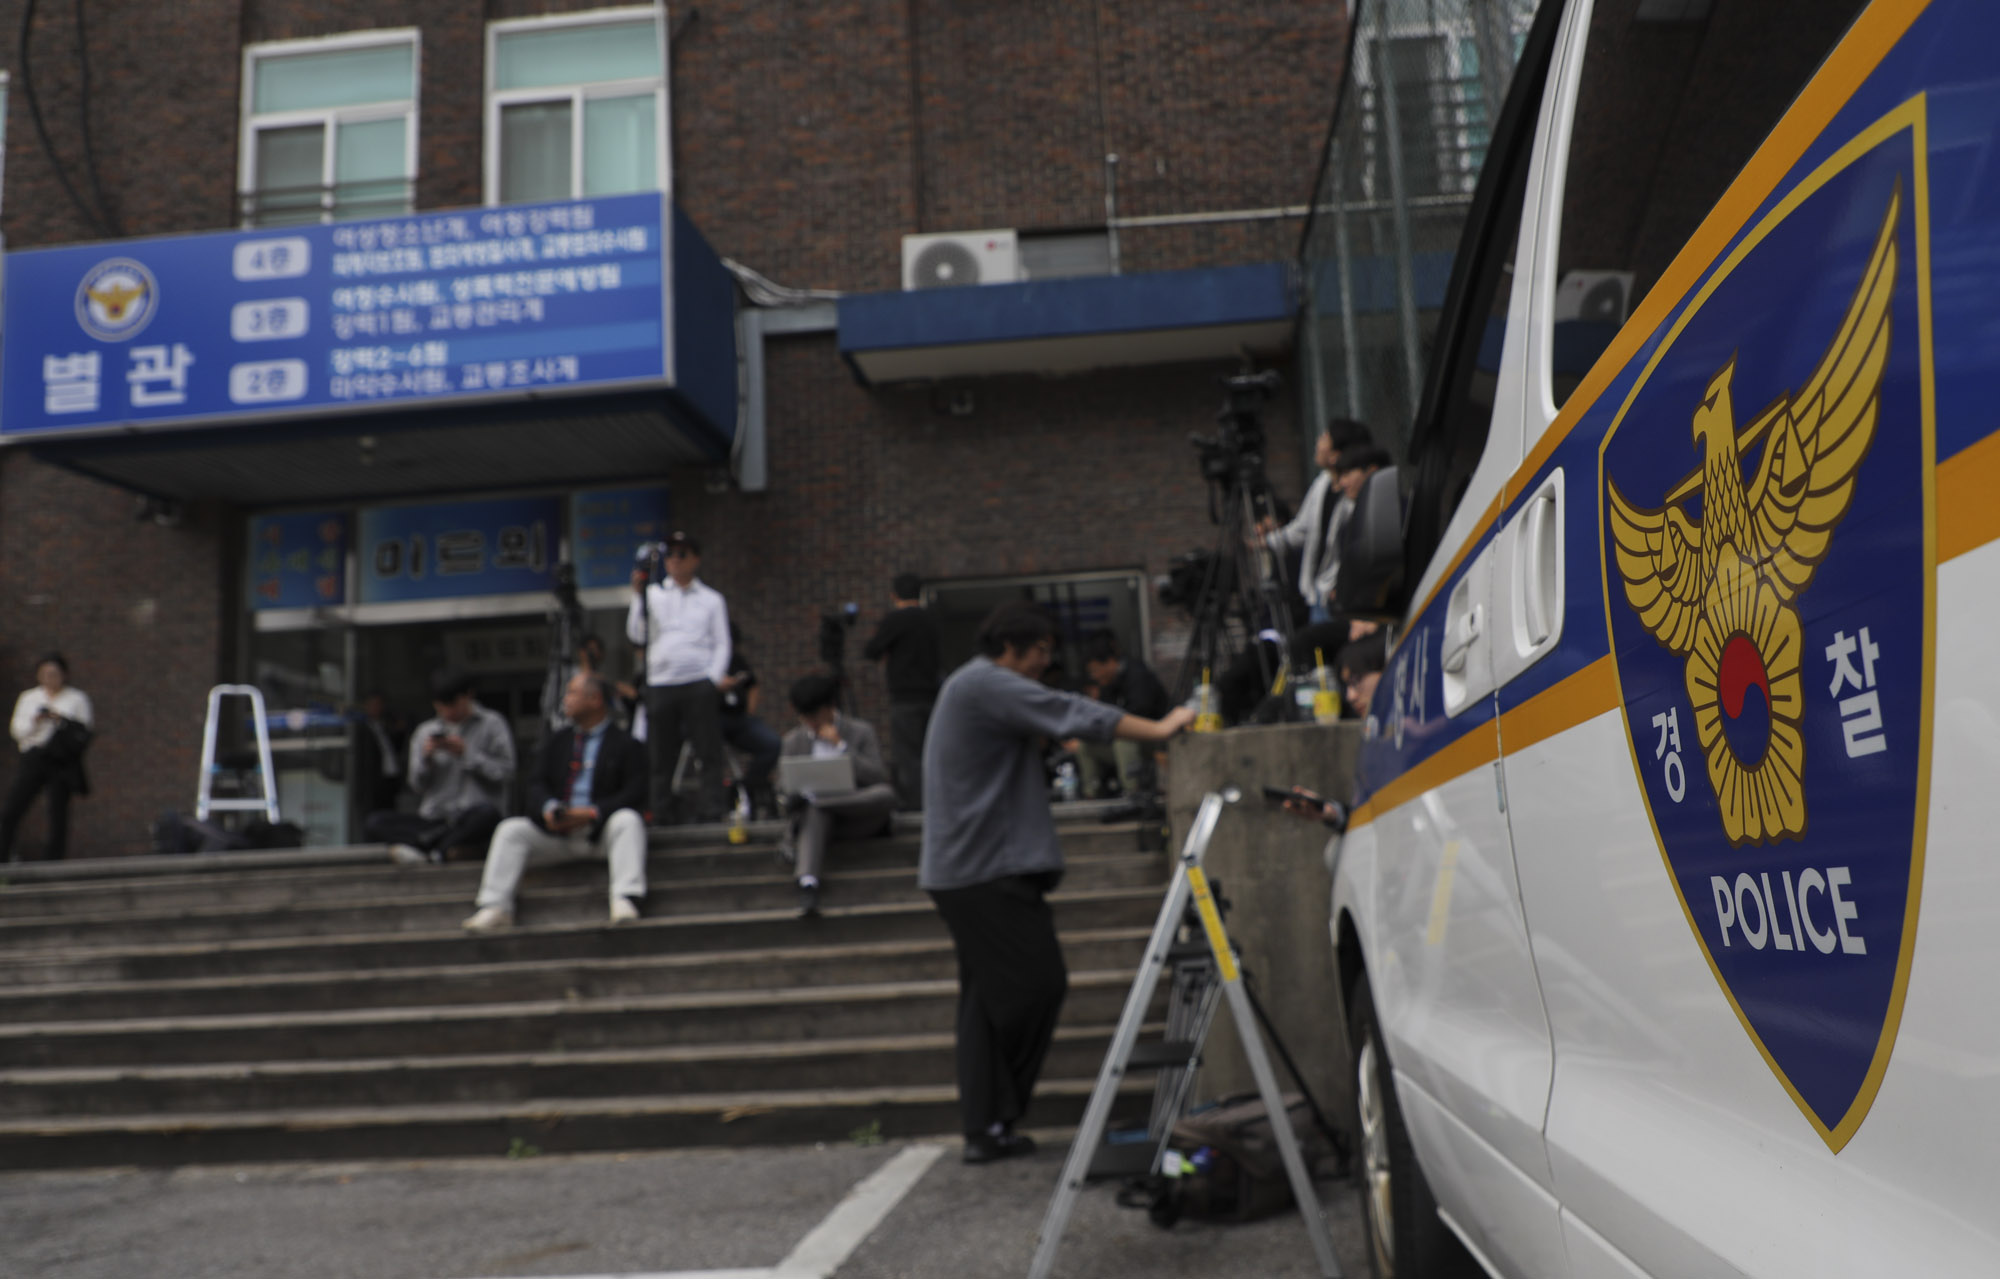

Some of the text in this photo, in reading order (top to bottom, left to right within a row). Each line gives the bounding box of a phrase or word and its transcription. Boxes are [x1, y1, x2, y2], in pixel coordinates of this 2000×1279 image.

[248, 245, 290, 273] 4층
[247, 306, 290, 334] 3층
[246, 367, 289, 396] 2층
[1710, 865, 1868, 956] POLICE
